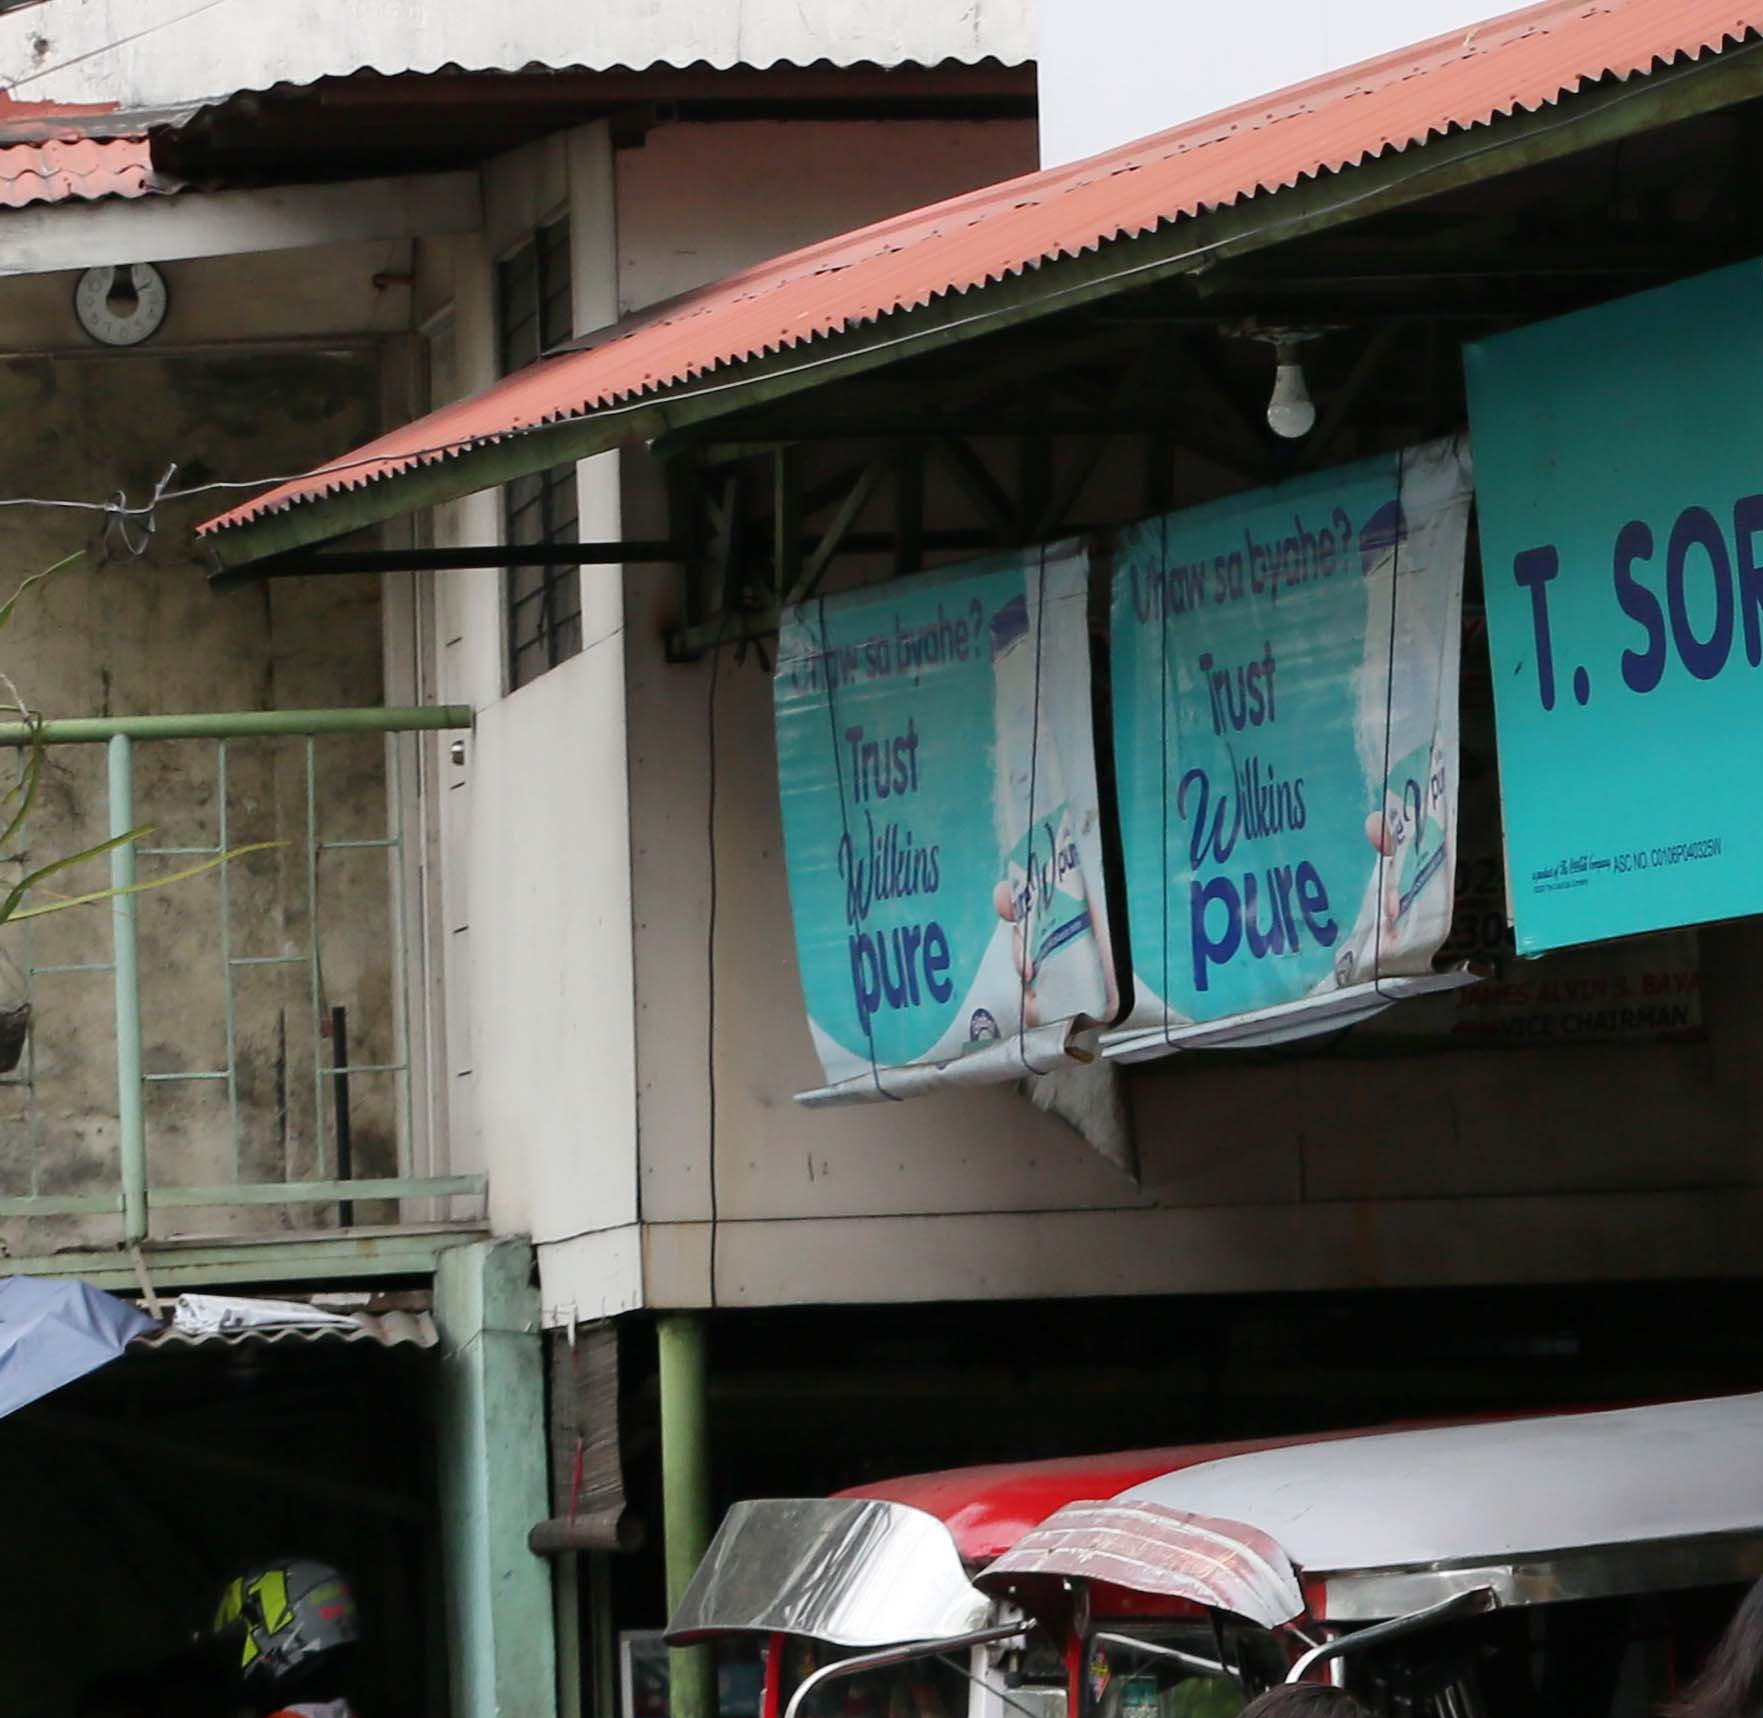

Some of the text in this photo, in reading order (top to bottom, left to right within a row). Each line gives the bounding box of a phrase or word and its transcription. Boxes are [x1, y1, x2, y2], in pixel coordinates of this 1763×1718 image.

[1212, 555, 1244, 606] sa
[1250, 506, 1353, 594] byahe?
[863, 635, 892, 676] sa
[897, 606, 984, 686] byahe?
[1514, 544, 1590, 711] T.
[1199, 640, 1276, 737] Trust
[845, 718, 920, 805] Trust
[1175, 743, 1305, 873] Wilkins
[837, 810, 940, 926] Wilkins
[848, 918, 953, 1037] pure
[1189, 858, 1338, 992] pure
[1560, 1003, 1691, 1036] CHAIRMAN
